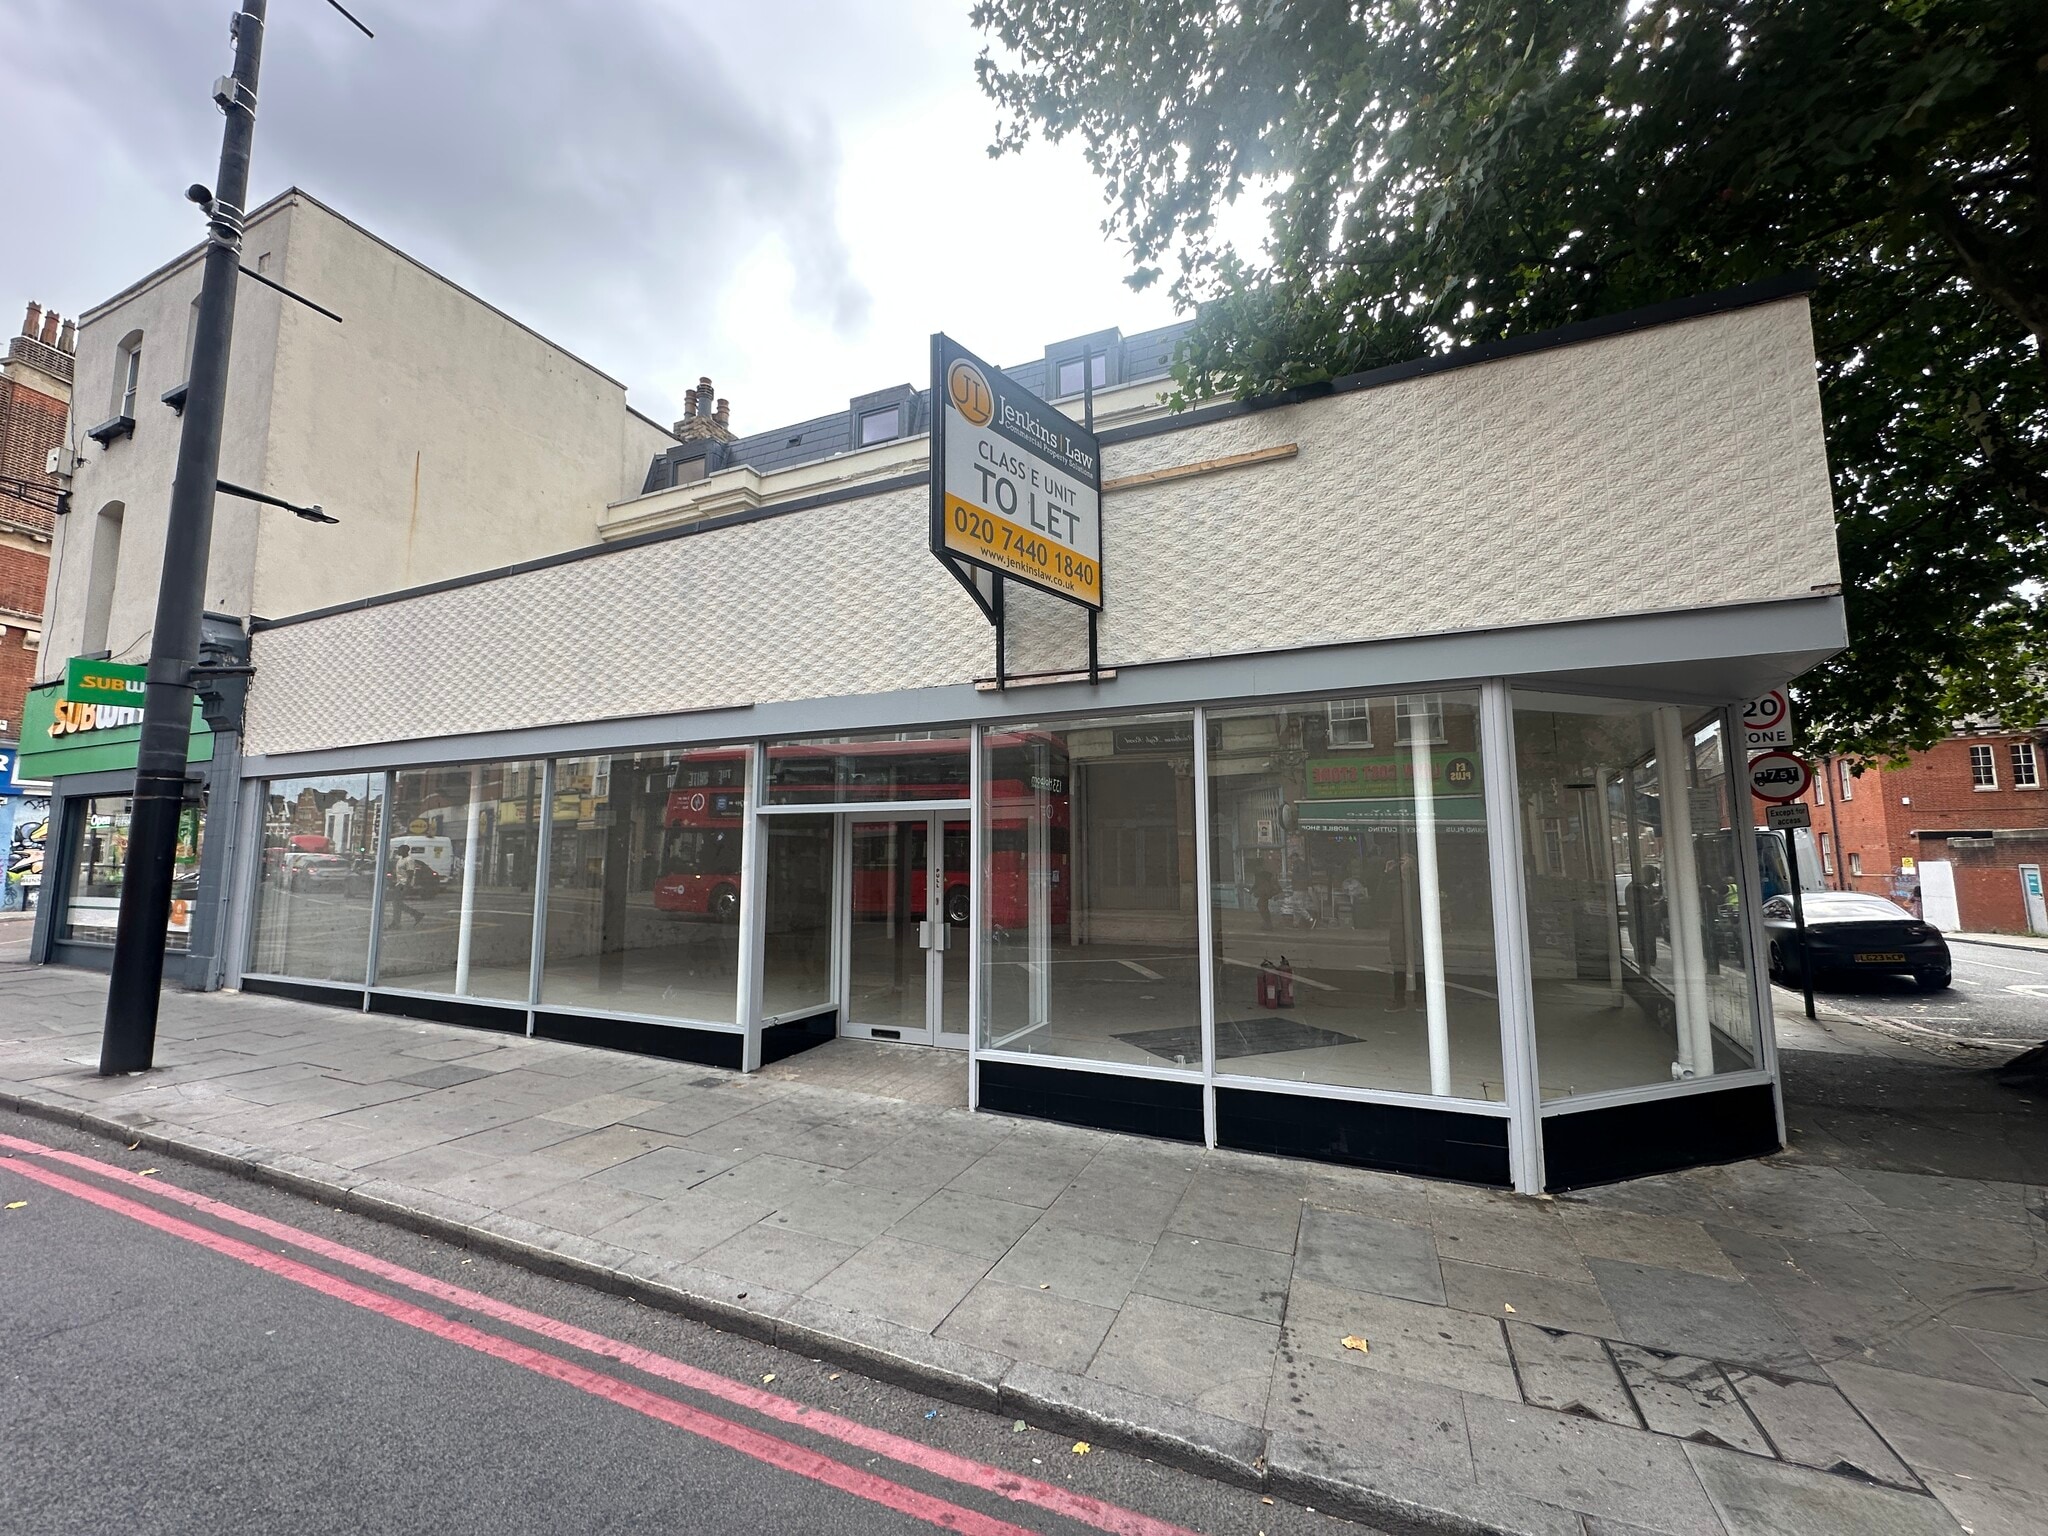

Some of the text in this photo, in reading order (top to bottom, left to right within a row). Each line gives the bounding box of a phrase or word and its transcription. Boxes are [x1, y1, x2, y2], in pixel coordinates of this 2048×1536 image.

[999, 395, 1093, 469] Jenkins Law
[1005, 421, 1094, 479] Commercial Property Solutions
[978, 440, 1076, 506] CLASS E UNIT
[974, 462, 1080, 545] TO LET
[954, 506, 1093, 586] 020 7440 1840
[980, 545, 1076, 592] www.jenkinslaw.co.uk
[80, 675, 145, 693] SUBW
[47, 698, 145, 738] SUBWA
[1743, 699, 1778, 717] 20
[1745, 731, 1787, 743] ONE
[90, 814, 111, 827] Open
[1770, 808, 1795, 818] Except
[1777, 817, 1801, 826] access
